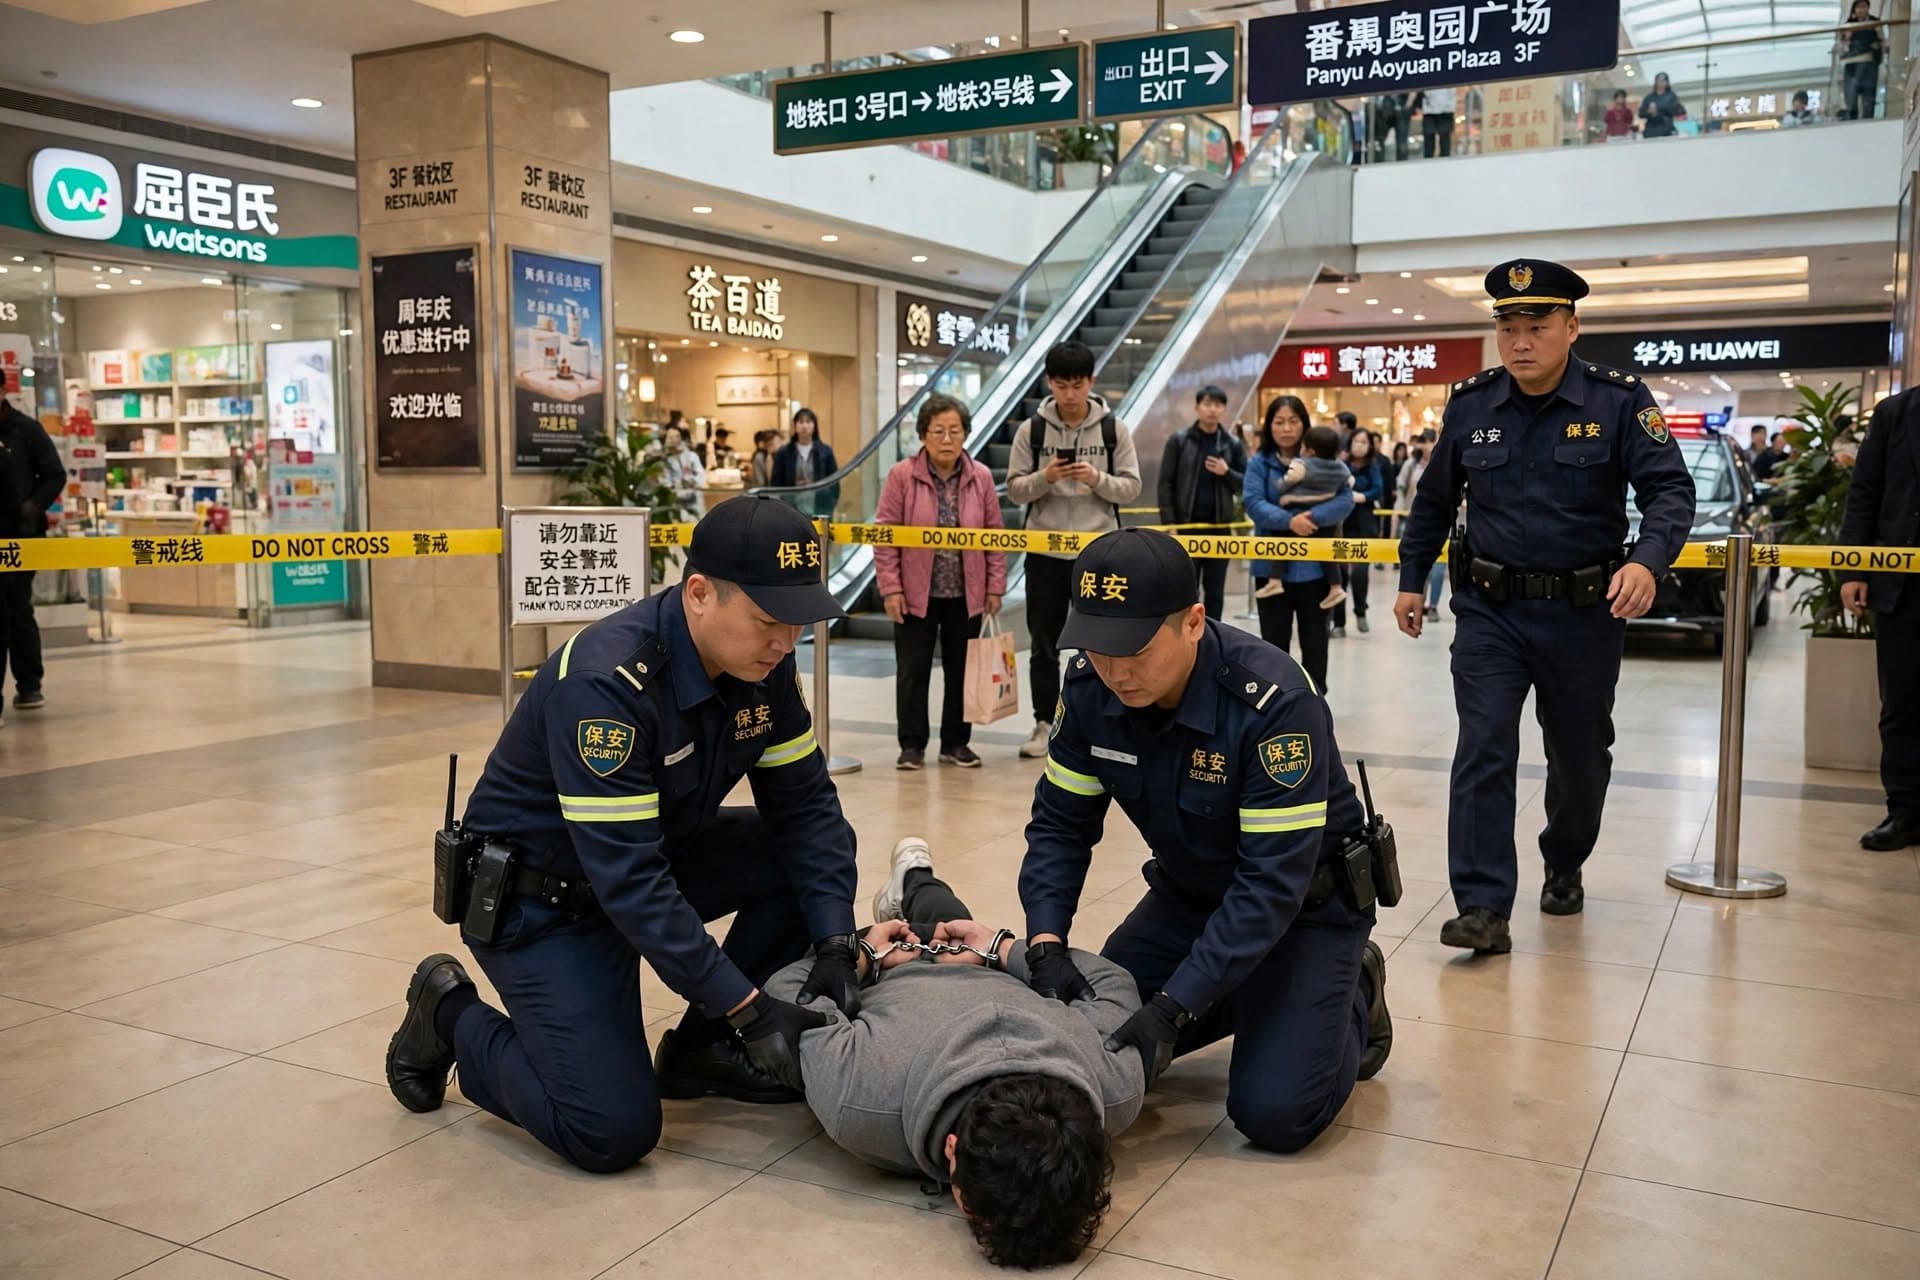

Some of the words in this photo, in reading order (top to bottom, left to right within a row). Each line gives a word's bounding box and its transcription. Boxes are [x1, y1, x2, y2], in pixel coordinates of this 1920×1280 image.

[1139, 46, 1190, 78] 出口
[1305, 66, 1364, 87] Panyu
[1368, 56, 1442, 81] Aoyuan
[1448, 49, 1501, 71] Plaza
[1514, 42, 1540, 64] 3F
[786, 97, 847, 129] 地铁口
[855, 90, 908, 121] 3号口
[936, 74, 1036, 113] 地铁3号线
[1140, 79, 1187, 103] EXIT
[389, 167, 408, 188] 3F
[524, 165, 543, 187] 3F
[134, 162, 279, 235] 屈臣氏
[385, 188, 458, 211] RESTAURANT
[521, 191, 589, 219] RESTAURANT
[144, 223, 268, 262] Watsons
[687, 265, 786, 323] 茶百道
[398, 296, 452, 324] 周年庆
[690, 311, 723, 333] TEA
[727, 316, 784, 341] BAIDAO
[382, 324, 470, 355] 优惠进行中
[1338, 344, 1437, 372] 蜜雪冰城
[1633, 340, 1684, 366] 华为
[1690, 340, 1780, 361] HUAWEI
[1352, 367, 1414, 385] MIXUE
[389, 392, 462, 419] 欢迎光临
[1471, 428, 1501, 444] 公安
[1565, 422, 1601, 438] 保安
[539, 522, 618, 544] 请勿靠近
[851, 527, 894, 544] 警戒线
[922, 531, 943, 545] DO
[947, 531, 976, 547] NOT
[980, 533, 1028, 548] CROSS
[1047, 533, 1081, 552] 警戒
[132, 538, 204, 565] 警戒线
[252, 539, 280, 559] DO
[287, 538, 325, 558] NOT
[332, 536, 390, 555] CROSS
[413, 532, 449, 555] 警戒
[540, 549, 618, 570] 安全警戒
[776, 540, 820, 569] 保安
[1188, 539, 1212, 554] DO
[1217, 540, 1250, 555] NOT
[1254, 541, 1309, 557] CROSS
[1332, 540, 1369, 559] 警戒
[1830, 551, 1862, 566] DO
[1869, 551, 1916, 568] NOT
[525, 574, 632, 596] 配合警方工作
[1079, 570, 1129, 602] 保安
[519, 600, 546, 612] THANK
[549, 600, 565, 611] YOU
[567, 600, 581, 611] FOR
[734, 704, 771, 729] 保安
[585, 724, 628, 749] 保安
[734, 722, 773, 741] SECURITY
[583, 747, 626, 761] SECURITY
[1191, 748, 1226, 772] 保安
[1267, 740, 1305, 763] 保安
[1189, 769, 1227, 785] SECURITY
